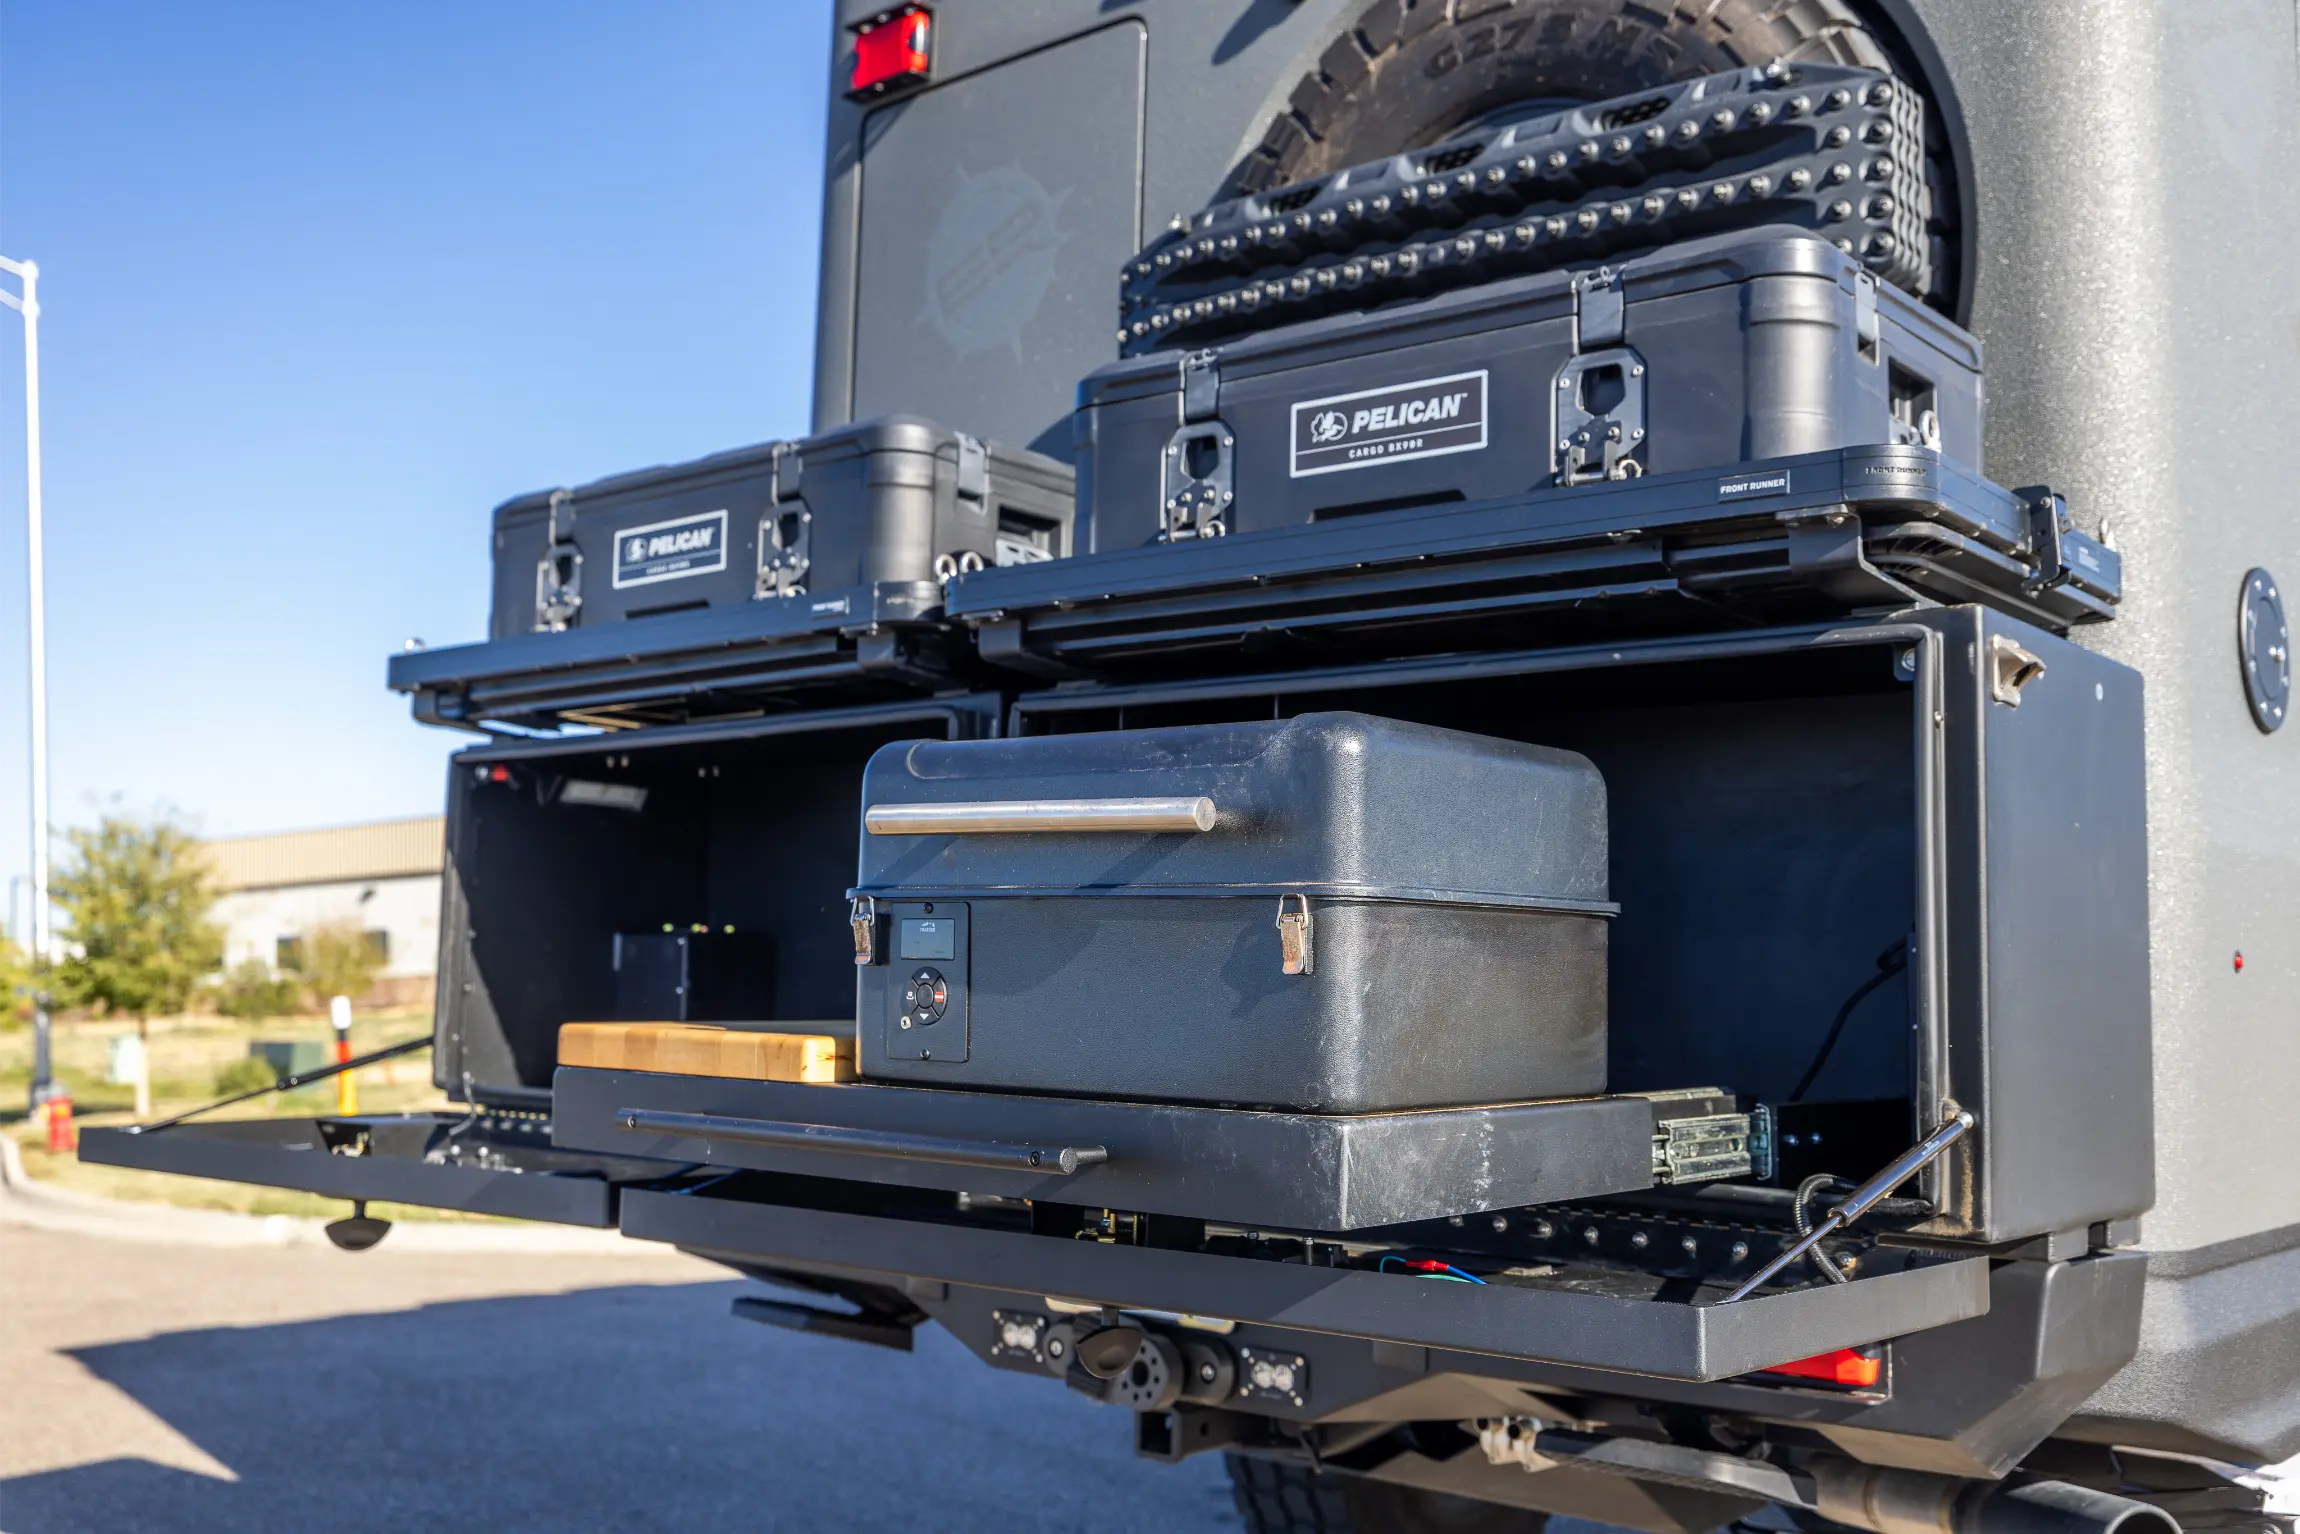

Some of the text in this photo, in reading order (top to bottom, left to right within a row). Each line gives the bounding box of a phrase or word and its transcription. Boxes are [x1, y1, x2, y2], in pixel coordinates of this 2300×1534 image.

[1351, 393, 1463, 434] PELICAN
[1348, 444, 1384, 460] CARGO
[1865, 466, 1895, 475] FRONT
[1720, 478, 1786, 494] FRONT RUNNER
[648, 526, 713, 558] PELICAN
